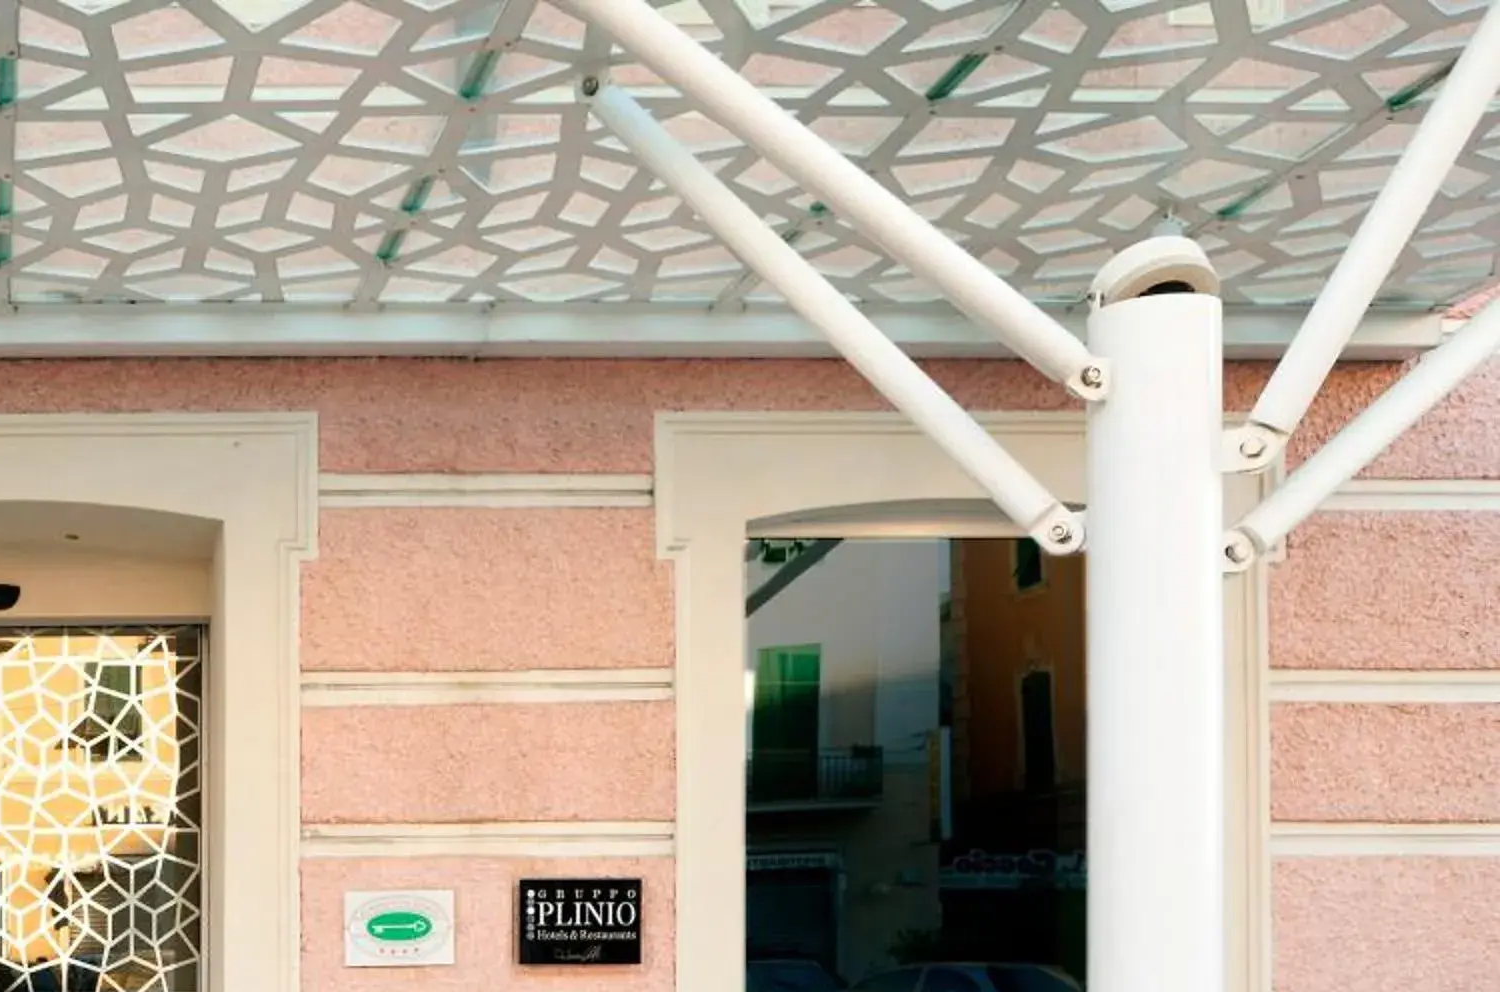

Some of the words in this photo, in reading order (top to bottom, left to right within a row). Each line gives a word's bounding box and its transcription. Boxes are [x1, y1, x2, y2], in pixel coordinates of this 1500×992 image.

[536, 889, 637, 900] GRUPPO
[536, 901, 637, 927] PLINIO
[536, 930, 569, 941] Hotels
[569, 930, 578, 941] &
